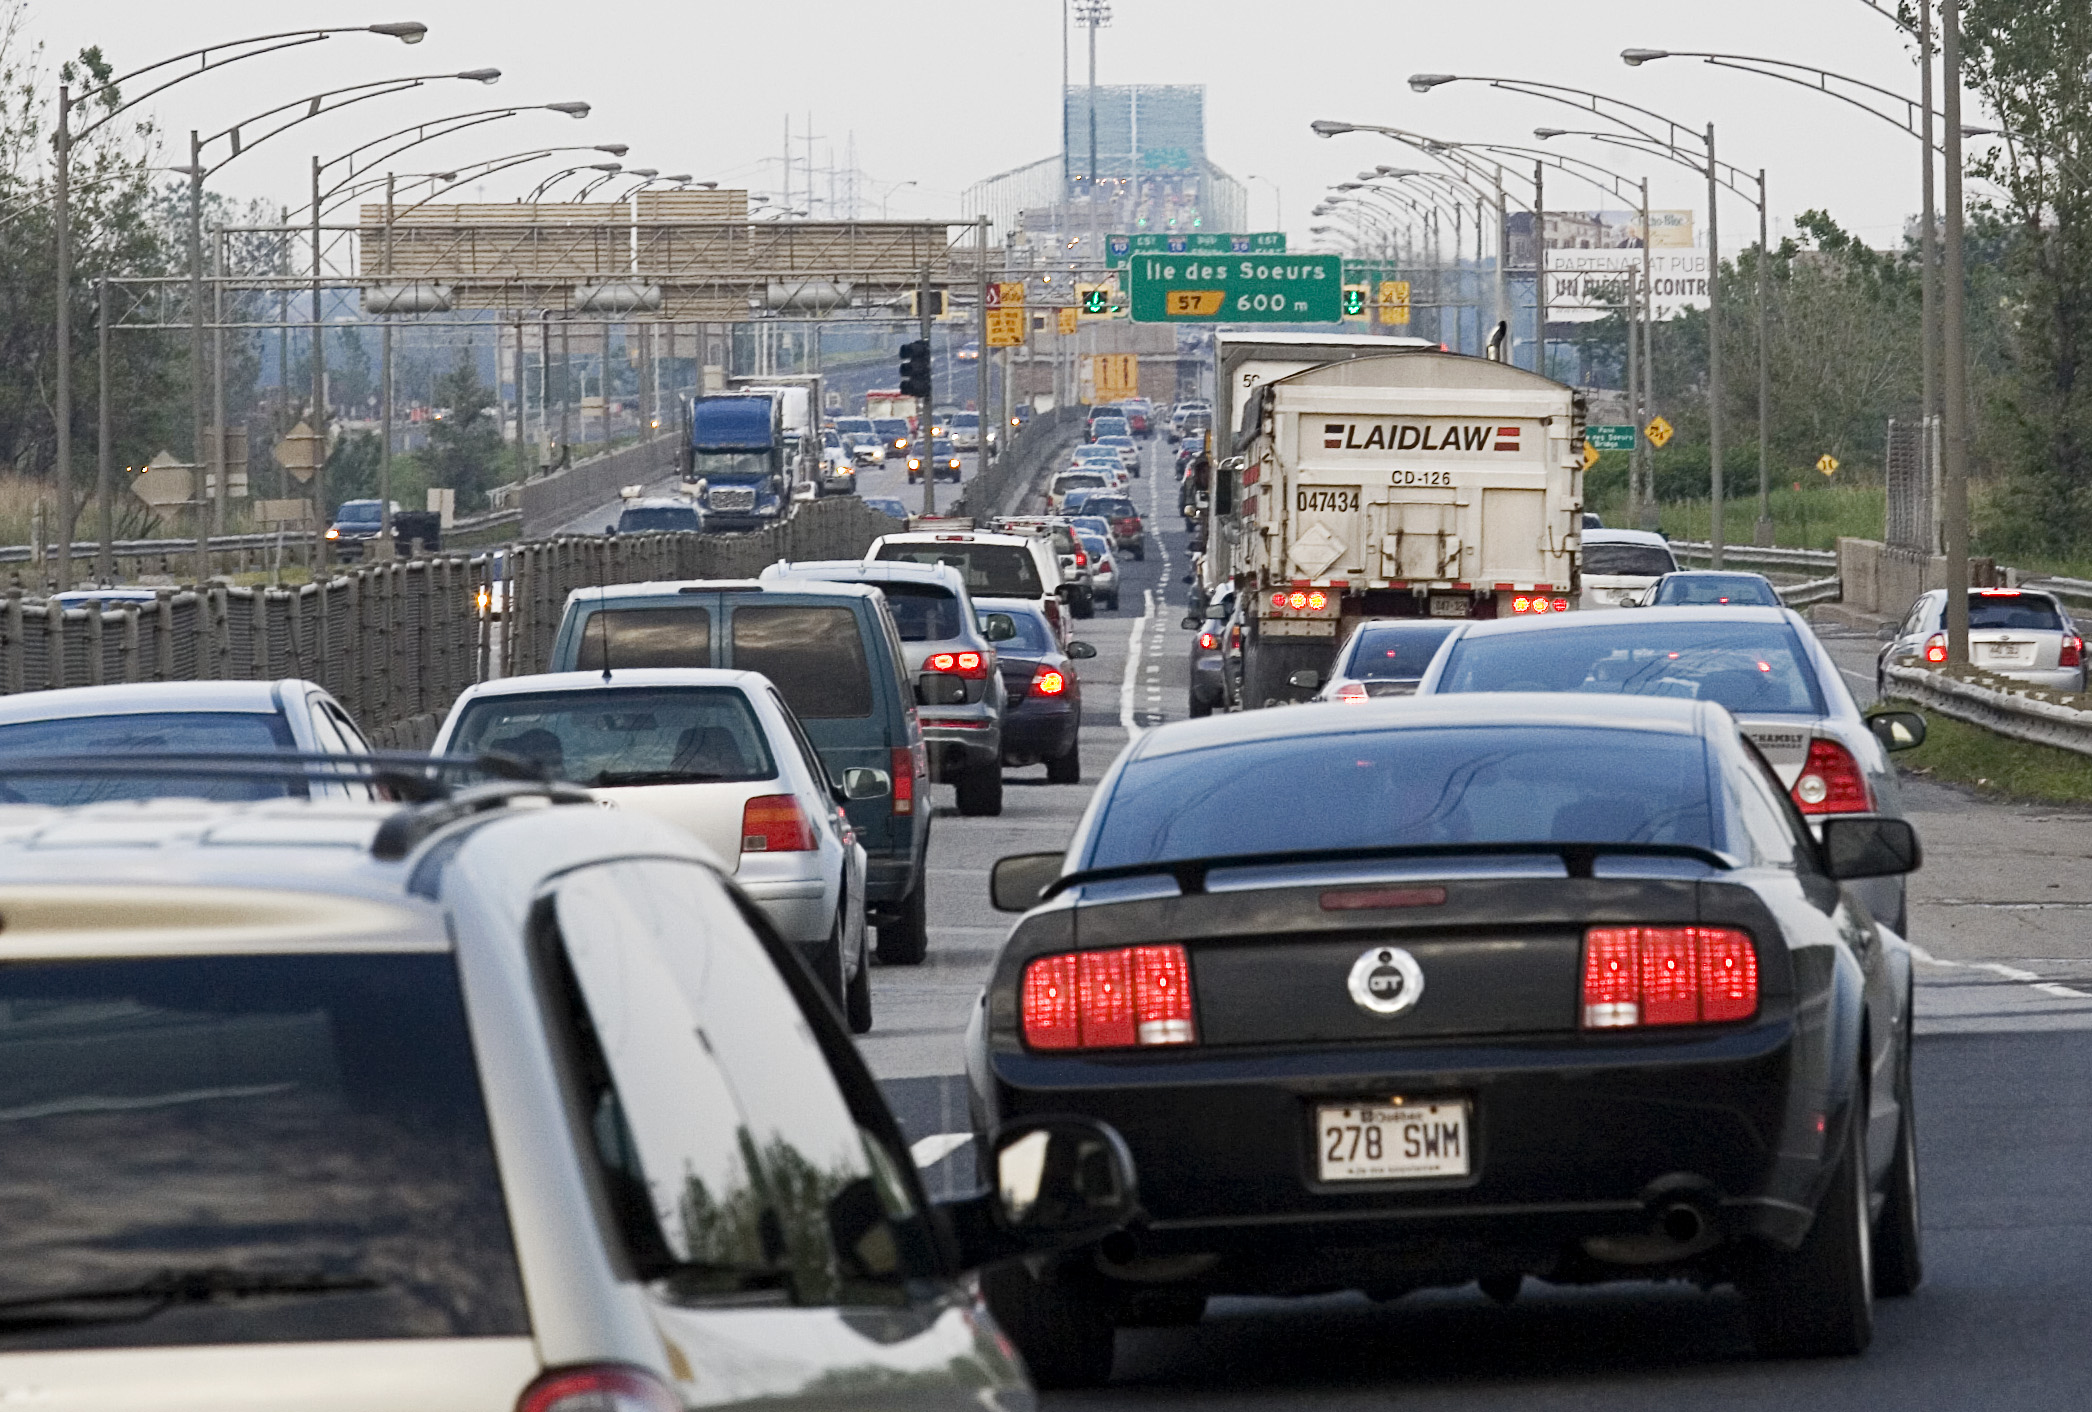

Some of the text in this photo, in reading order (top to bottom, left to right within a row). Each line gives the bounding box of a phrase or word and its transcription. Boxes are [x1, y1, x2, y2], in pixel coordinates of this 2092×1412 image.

[1185, 262, 1228, 280] des
[1240, 262, 1325, 280] Soeurs
[1555, 257, 1664, 272] PARTENARAT
[1556, 279, 1577, 296] UN
[1654, 278, 1710, 296] CONTR
[1178, 294, 1308, 311] 57 600 m
[1345, 424, 1492, 451] LAIDLAW
[1392, 470, 1450, 486] CD-126
[1297, 491, 1360, 513] 047434
[1326, 1123, 1460, 1162] 278 SWM
